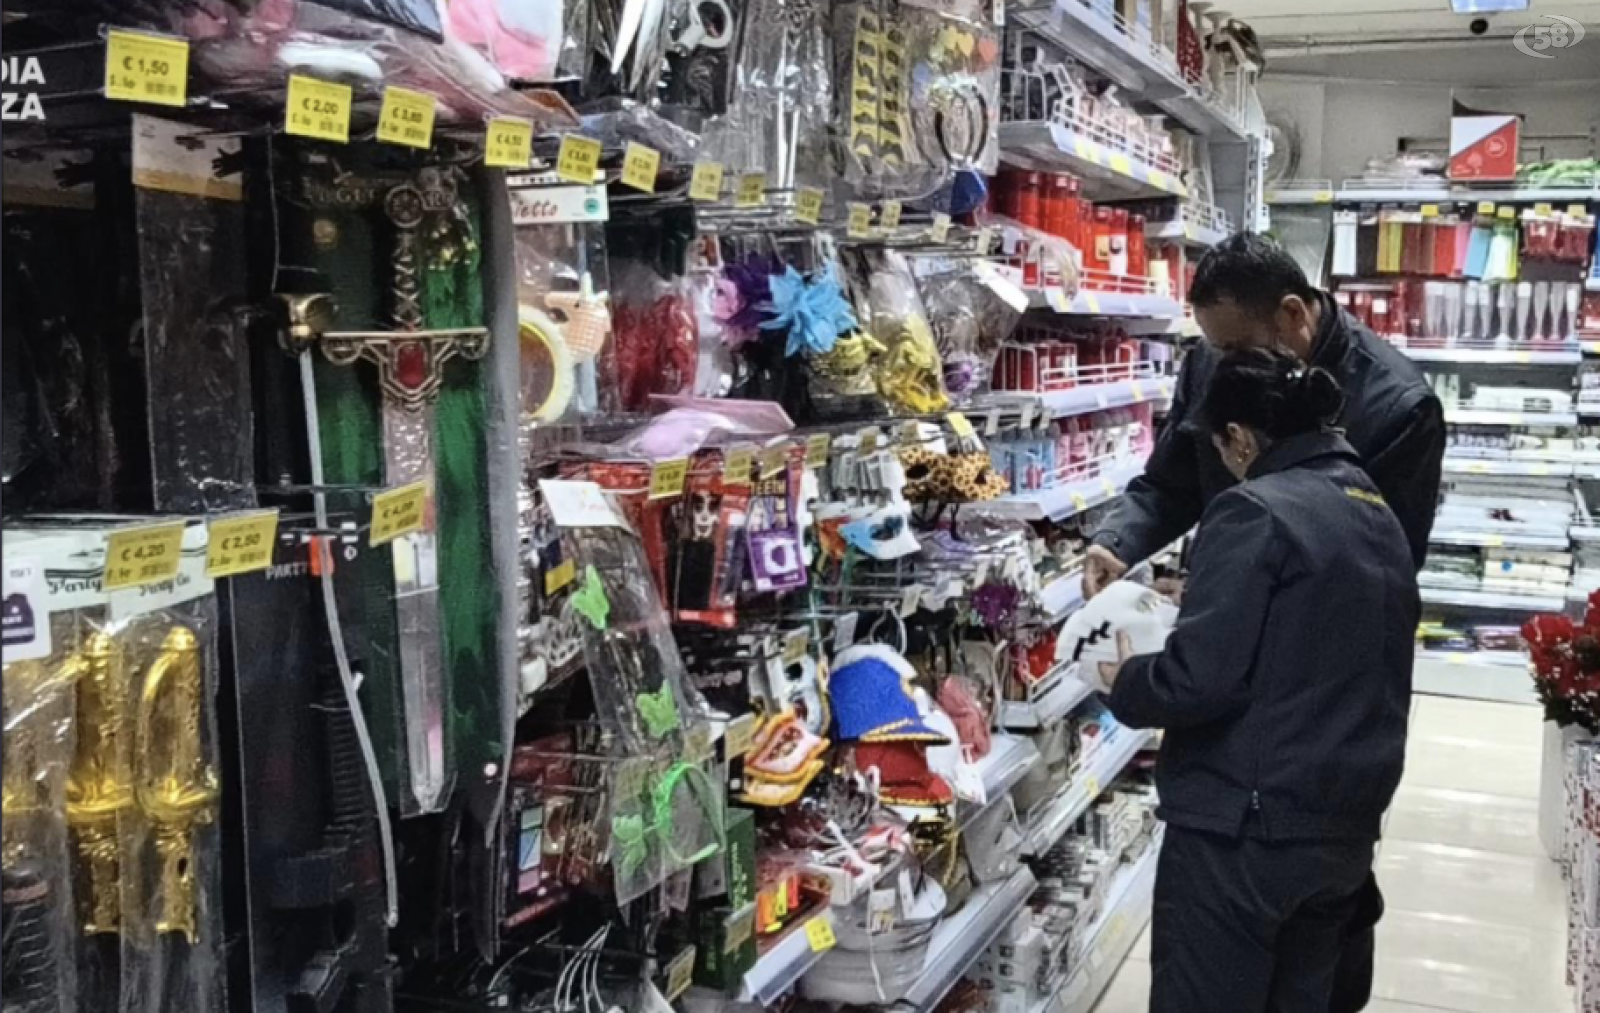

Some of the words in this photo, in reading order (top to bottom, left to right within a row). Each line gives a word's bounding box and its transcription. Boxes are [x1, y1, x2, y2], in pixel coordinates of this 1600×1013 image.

[122, 55, 133, 71] €
[138, 58, 169, 77] 1,50
[313, 99, 339, 115] 2,00
